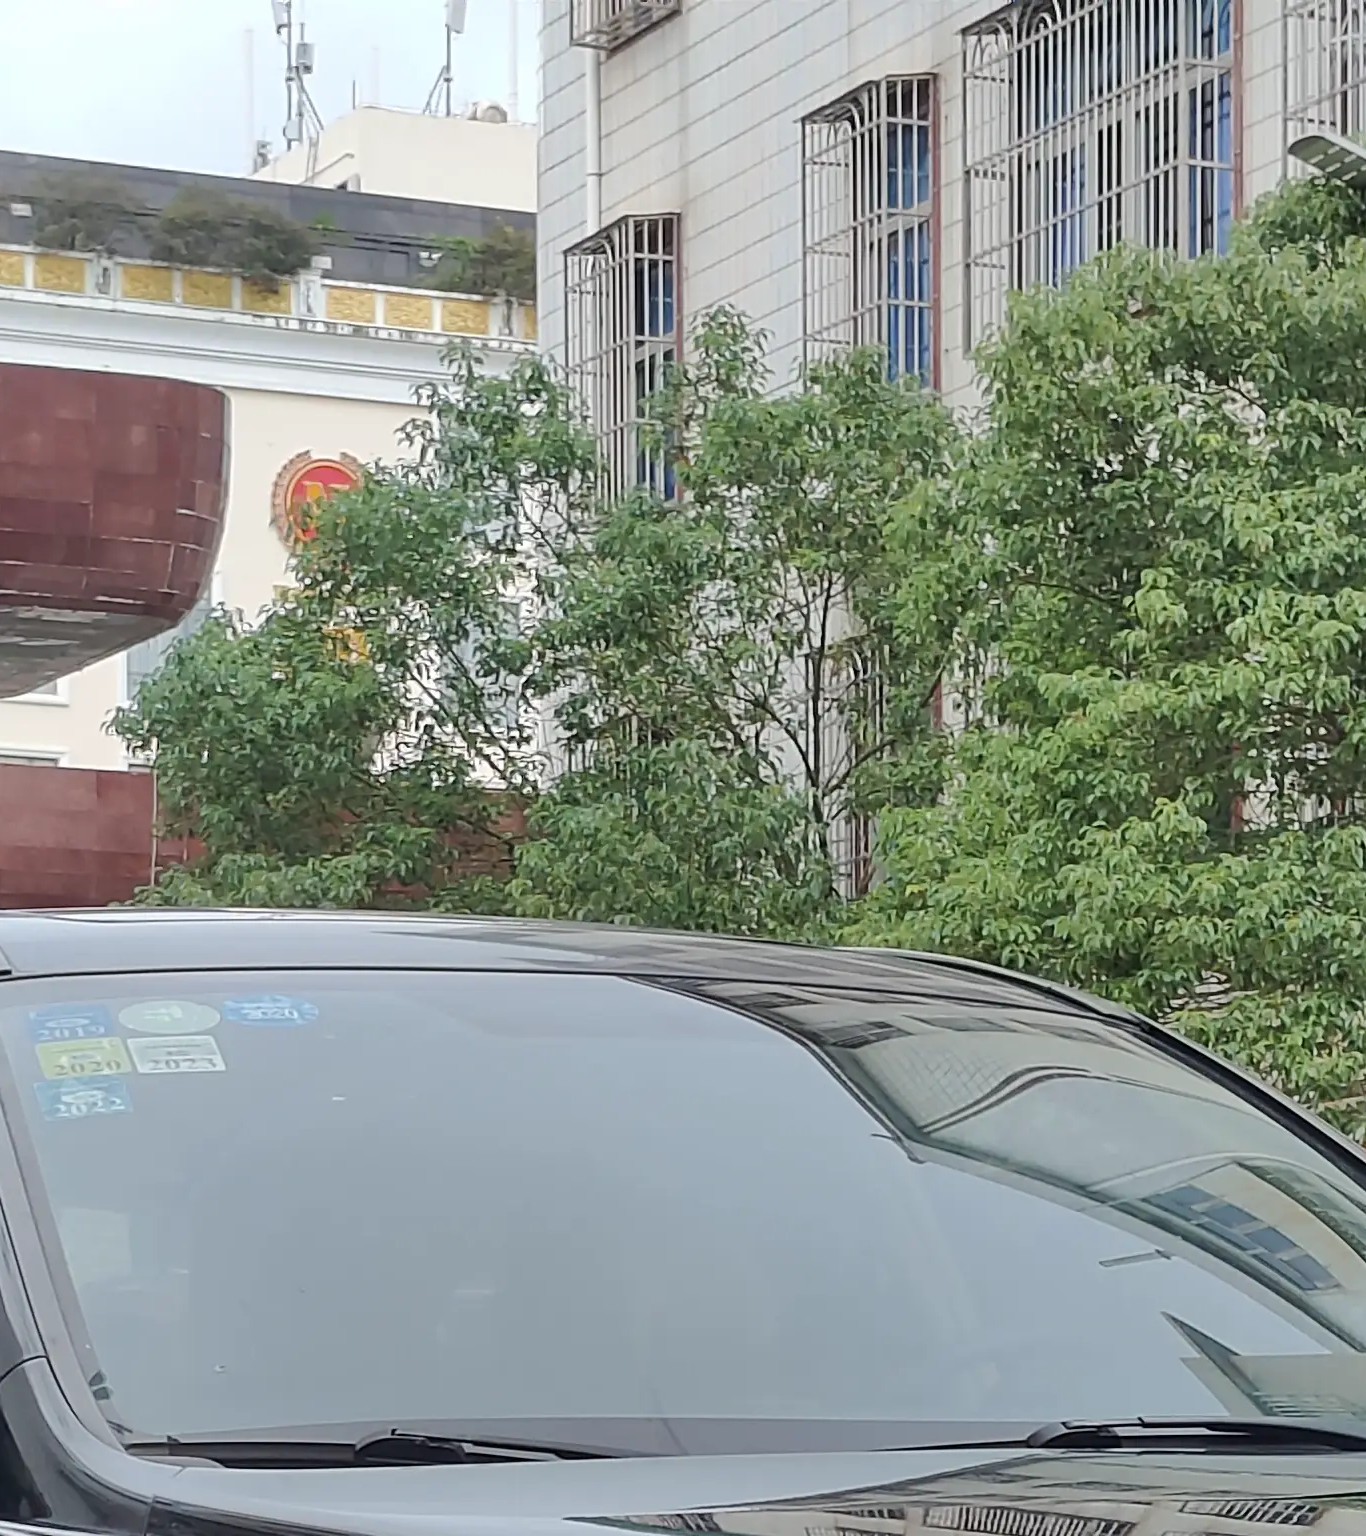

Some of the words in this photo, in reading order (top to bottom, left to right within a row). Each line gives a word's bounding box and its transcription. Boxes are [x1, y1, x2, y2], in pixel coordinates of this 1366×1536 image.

[53, 1059, 122, 1076] 2020
[147, 1057, 218, 1071] 2023
[54, 1097, 126, 1118] 2022
